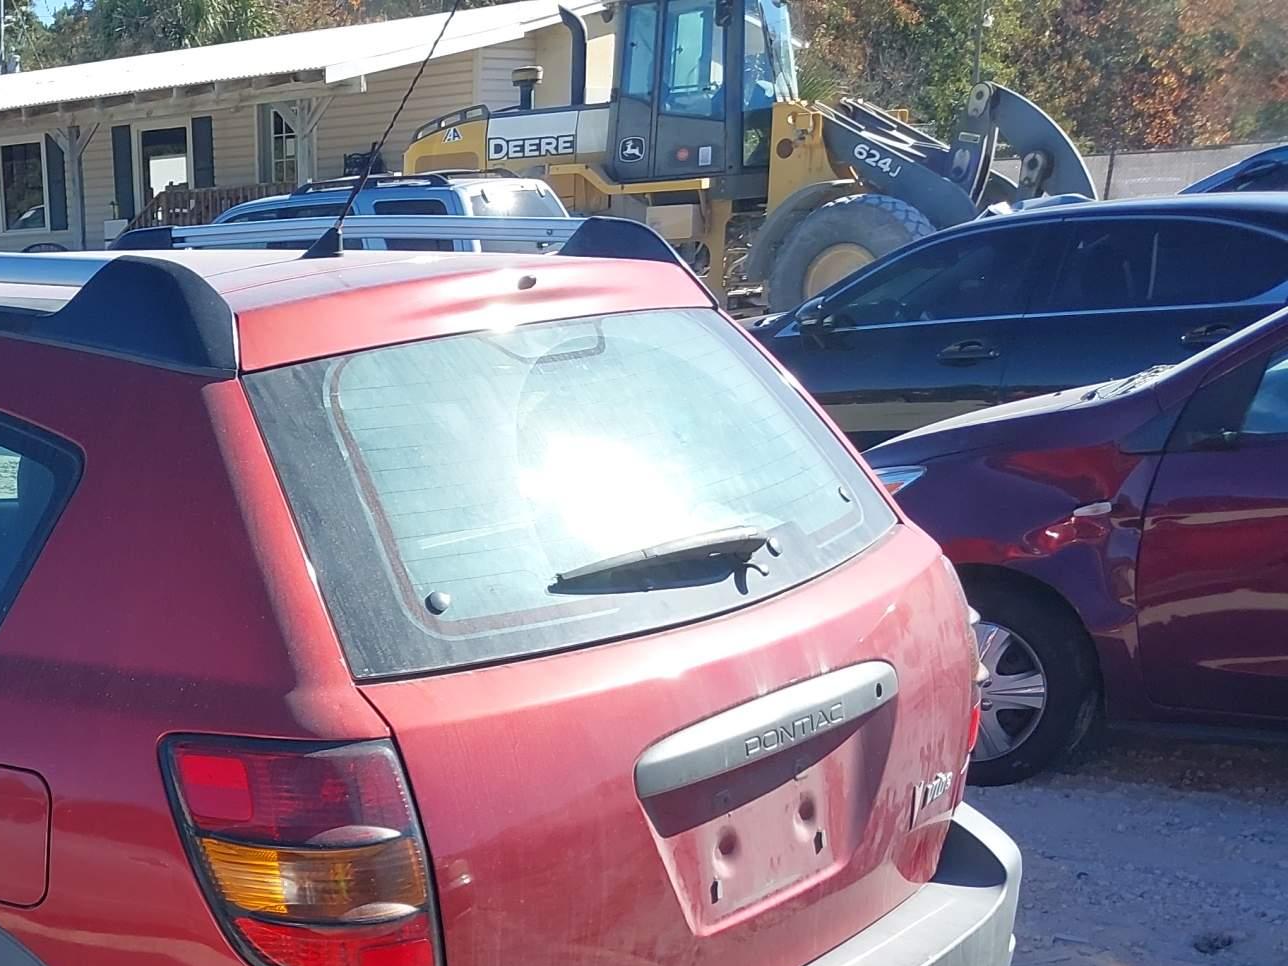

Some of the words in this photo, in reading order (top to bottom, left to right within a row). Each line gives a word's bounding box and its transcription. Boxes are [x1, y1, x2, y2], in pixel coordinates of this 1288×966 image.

[488, 134, 575, 161] DEERE
[853, 143, 902, 178] 624J
[744, 702, 844, 758] PONTIAC
